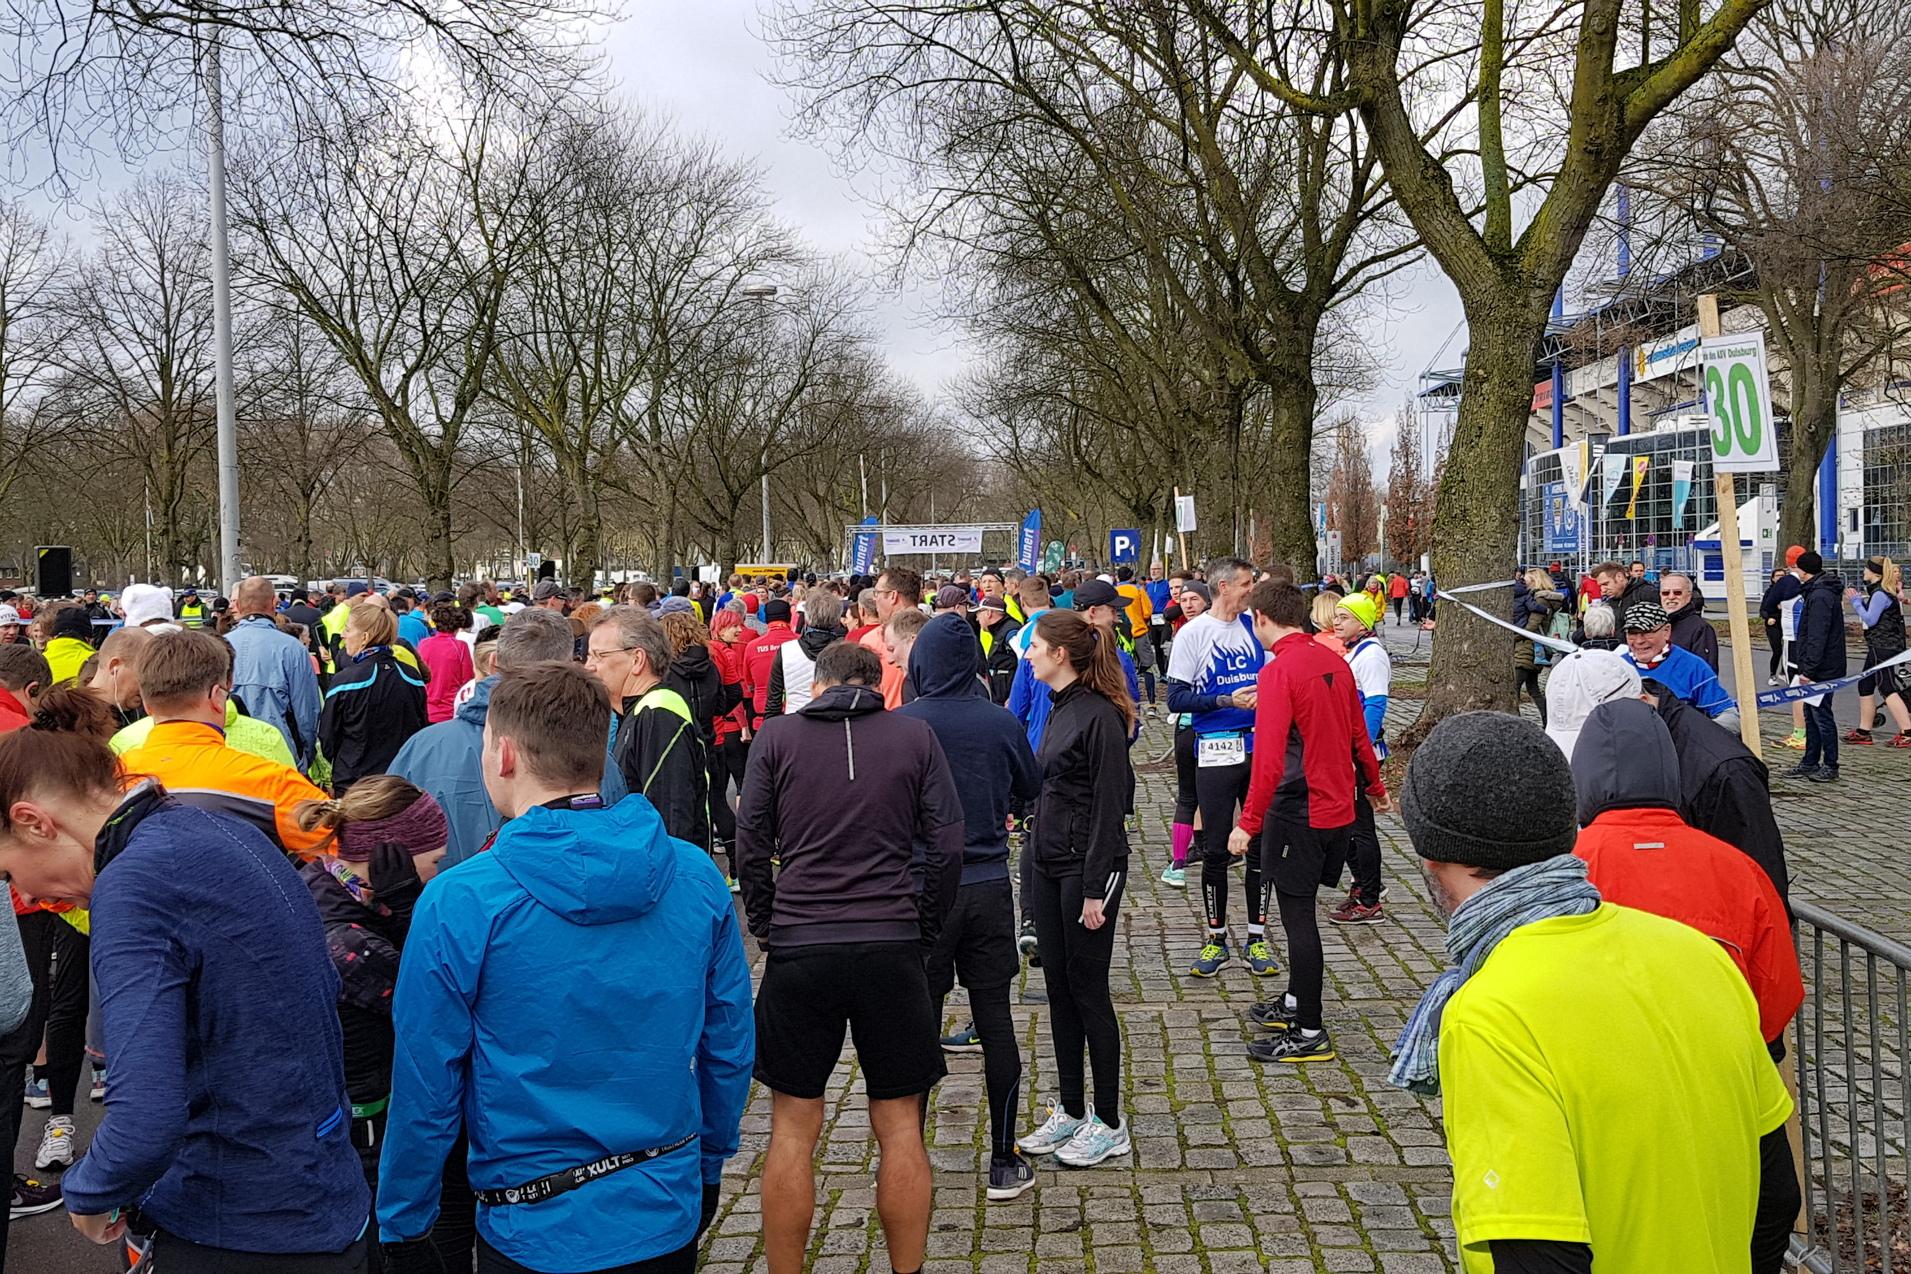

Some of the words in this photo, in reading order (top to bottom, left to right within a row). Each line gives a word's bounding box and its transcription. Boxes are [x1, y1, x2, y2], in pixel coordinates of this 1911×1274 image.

[1706, 362, 1762, 457] 30
[854, 535, 870, 574] bunert
[1019, 528, 1035, 567] bunert
[1226, 655, 1247, 671] LC
[1208, 741, 1233, 751] 4142
